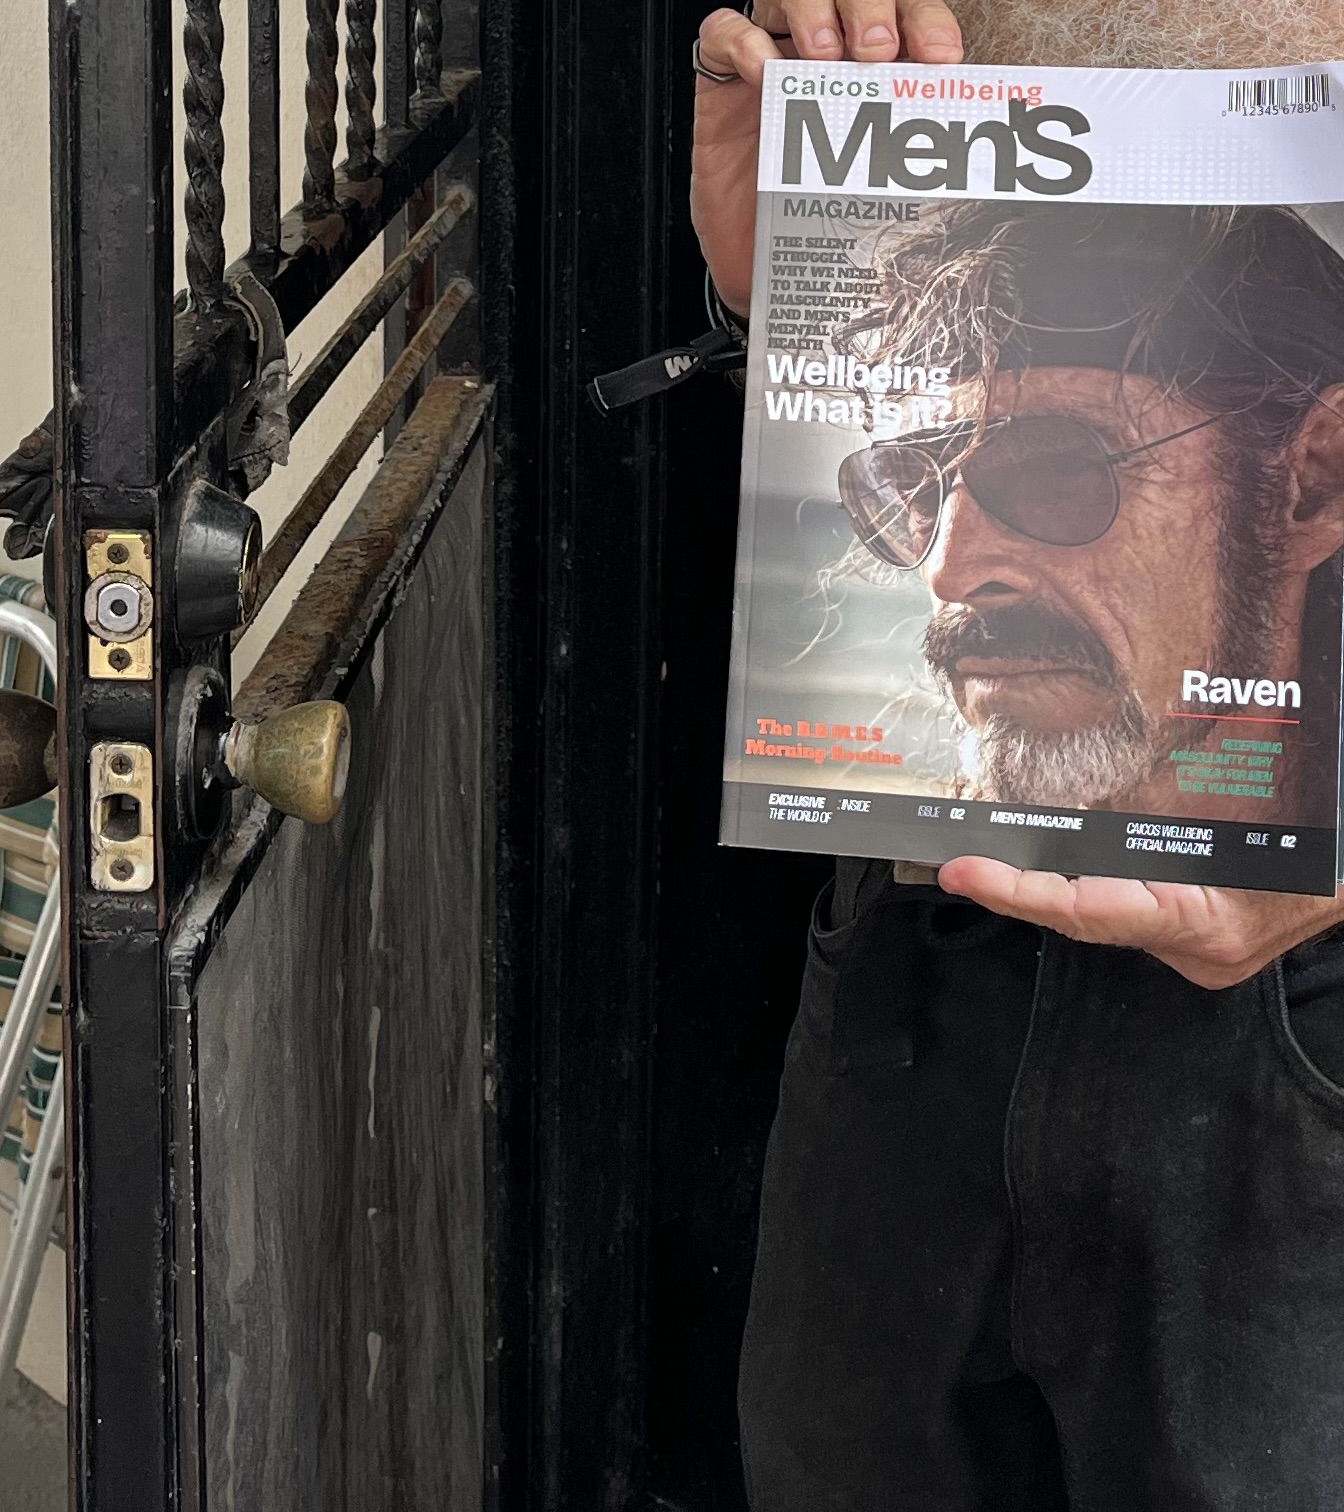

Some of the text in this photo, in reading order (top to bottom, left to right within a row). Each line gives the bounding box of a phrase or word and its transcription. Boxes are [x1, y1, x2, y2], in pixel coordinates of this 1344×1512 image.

[781, 75, 1043, 106] Caicos Wellbeing
[1242, 104, 1279, 117] 12345
[1282, 102, 1319, 115] 67890
[783, 198, 920, 222] MAGAZINE
[773, 236, 857, 249] THE SILENT
[772, 251, 848, 264] STRUGGLE
[771, 265, 878, 279] WHY WE NEED
[771, 279, 883, 294] TO TALK ABOUT
[770, 294, 871, 308] MASCULINITY
[769, 309, 801, 320] AND
[768, 323, 830, 336] MENTAL
[767, 337, 824, 350] HEALTH
[767, 354, 952, 397] Wellbeing
[764, 391, 953, 429] What is it?
[1183, 670, 1301, 708] Raven
[757, 719, 792, 737] The
[745, 739, 903, 765] Morning Routine
[768, 793, 826, 809] EXCLUSIVE
[769, 808, 833, 824] THE WORLD OF
[950, 807, 966, 820] 02
[990, 811, 1083, 830] MEN'S MAGAZINE
[1126, 822, 1213, 841] CAICOS WELLBEING
[1126, 837, 1214, 856] OFFICIAL MAGAZINE
[1280, 834, 1297, 848] 02
